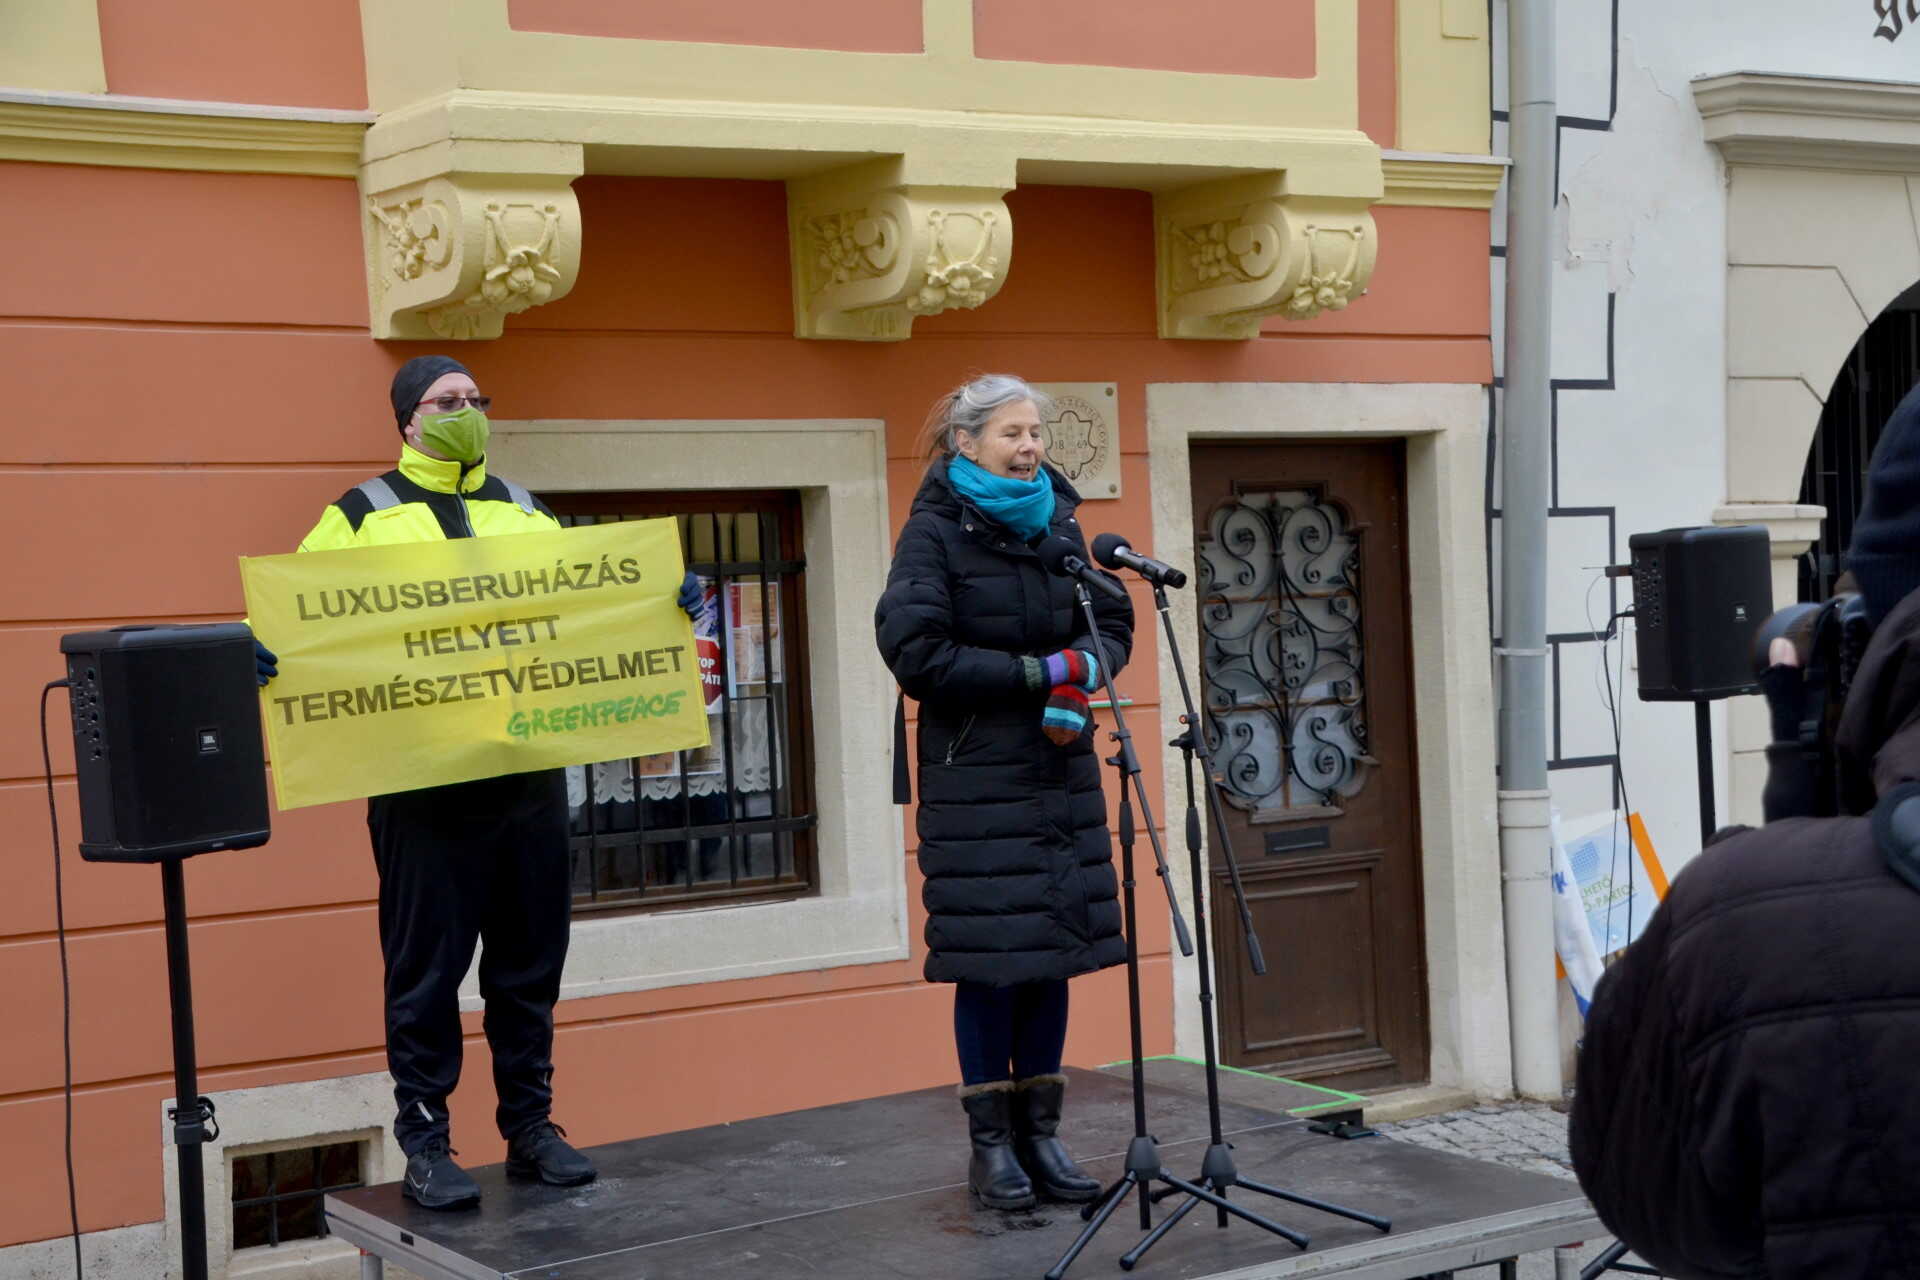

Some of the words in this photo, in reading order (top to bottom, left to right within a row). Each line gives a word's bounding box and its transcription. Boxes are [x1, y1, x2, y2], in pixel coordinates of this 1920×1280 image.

[296, 554, 642, 622] LUXUSBERUHÁZÁS
[403, 614, 560, 659] HELYETT
[274, 645, 685, 726] TERMÉSZETVÉDELMET
[506, 690, 686, 739] GREENPEACE
